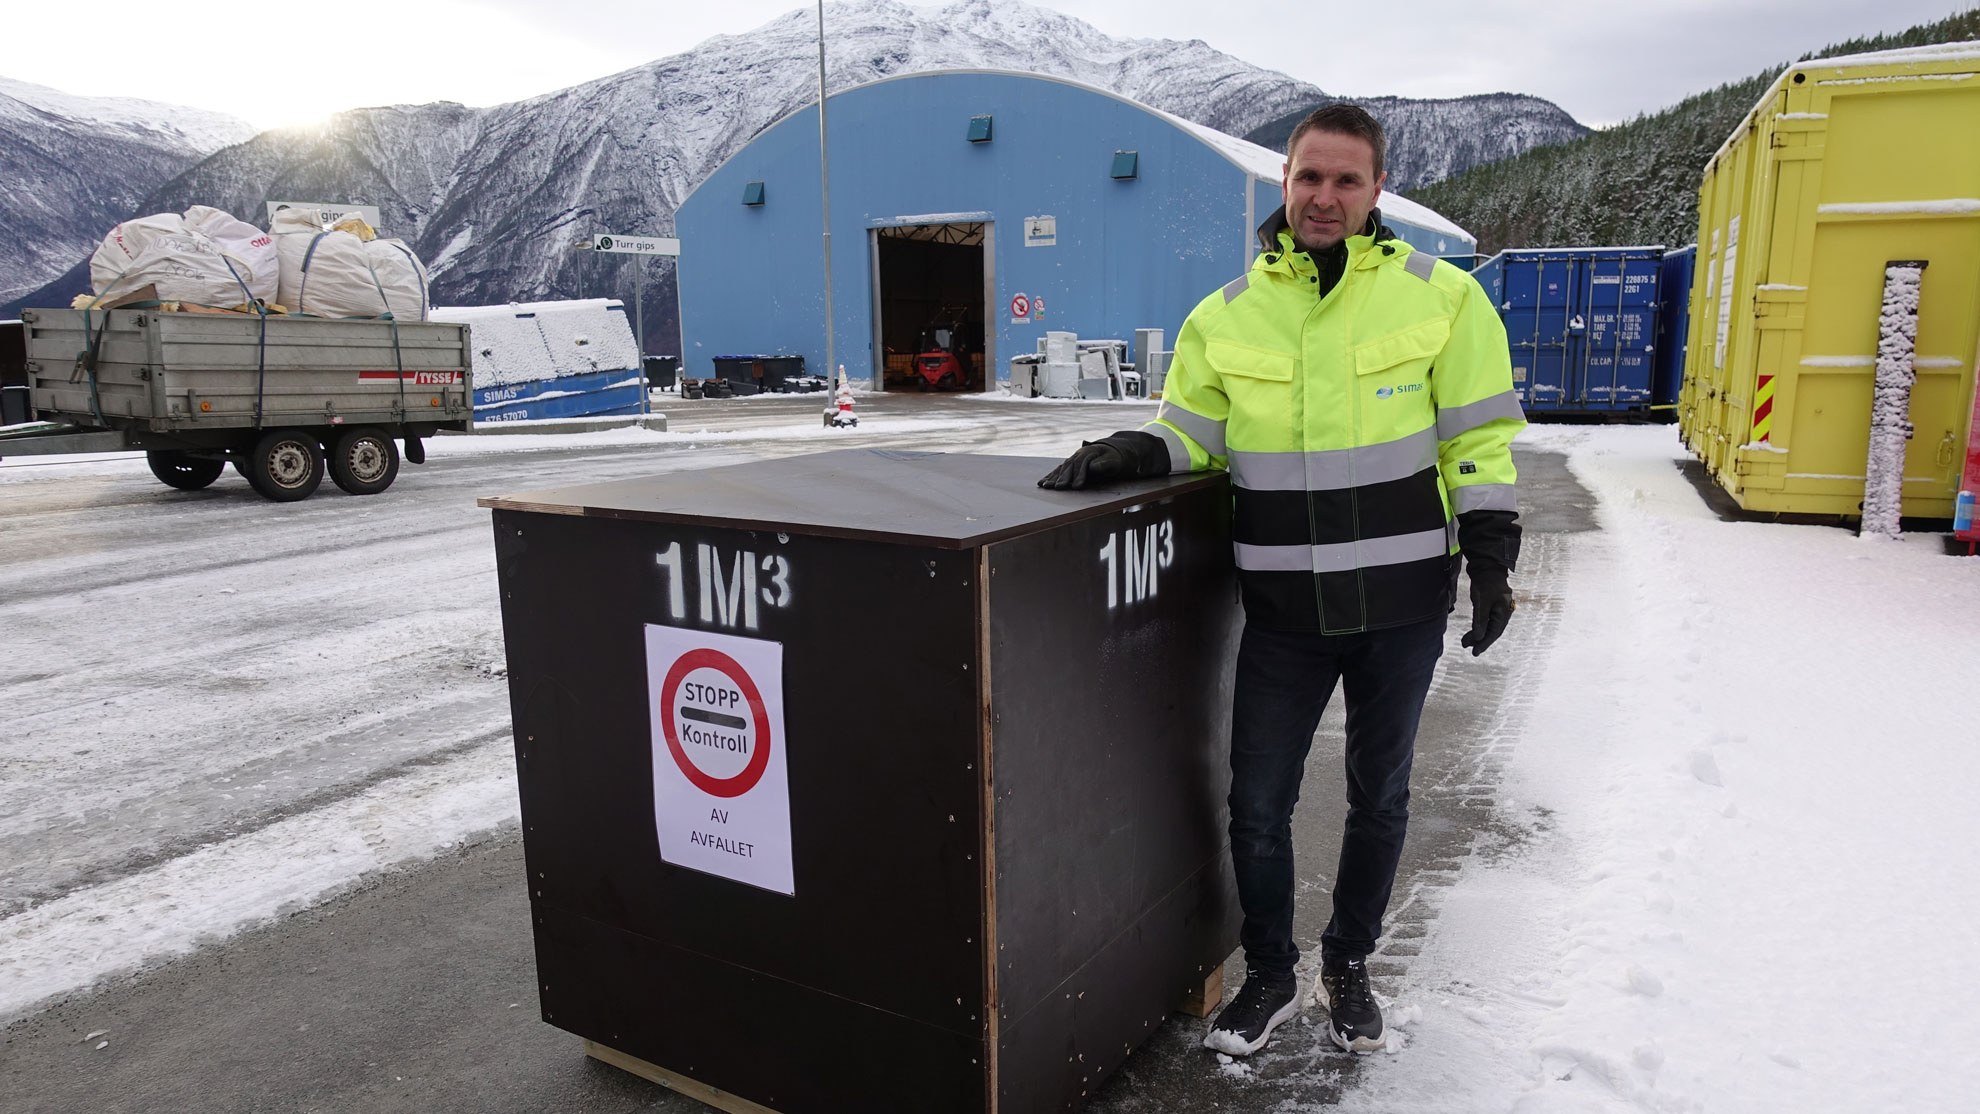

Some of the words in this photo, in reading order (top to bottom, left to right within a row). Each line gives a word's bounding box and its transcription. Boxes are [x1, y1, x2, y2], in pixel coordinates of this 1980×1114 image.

[615, 239, 634, 248] Turr
[636, 241, 655, 251] gips
[419, 372, 452, 384] TYSSE
[484, 389, 517, 403] SIMAS
[503, 410, 528, 421] 57070
[685, 682, 740, 709] STOPP
[682, 723, 747, 754] Kontroll
[710, 808, 729, 825] AV
[690, 830, 754, 858] AVFALLET
